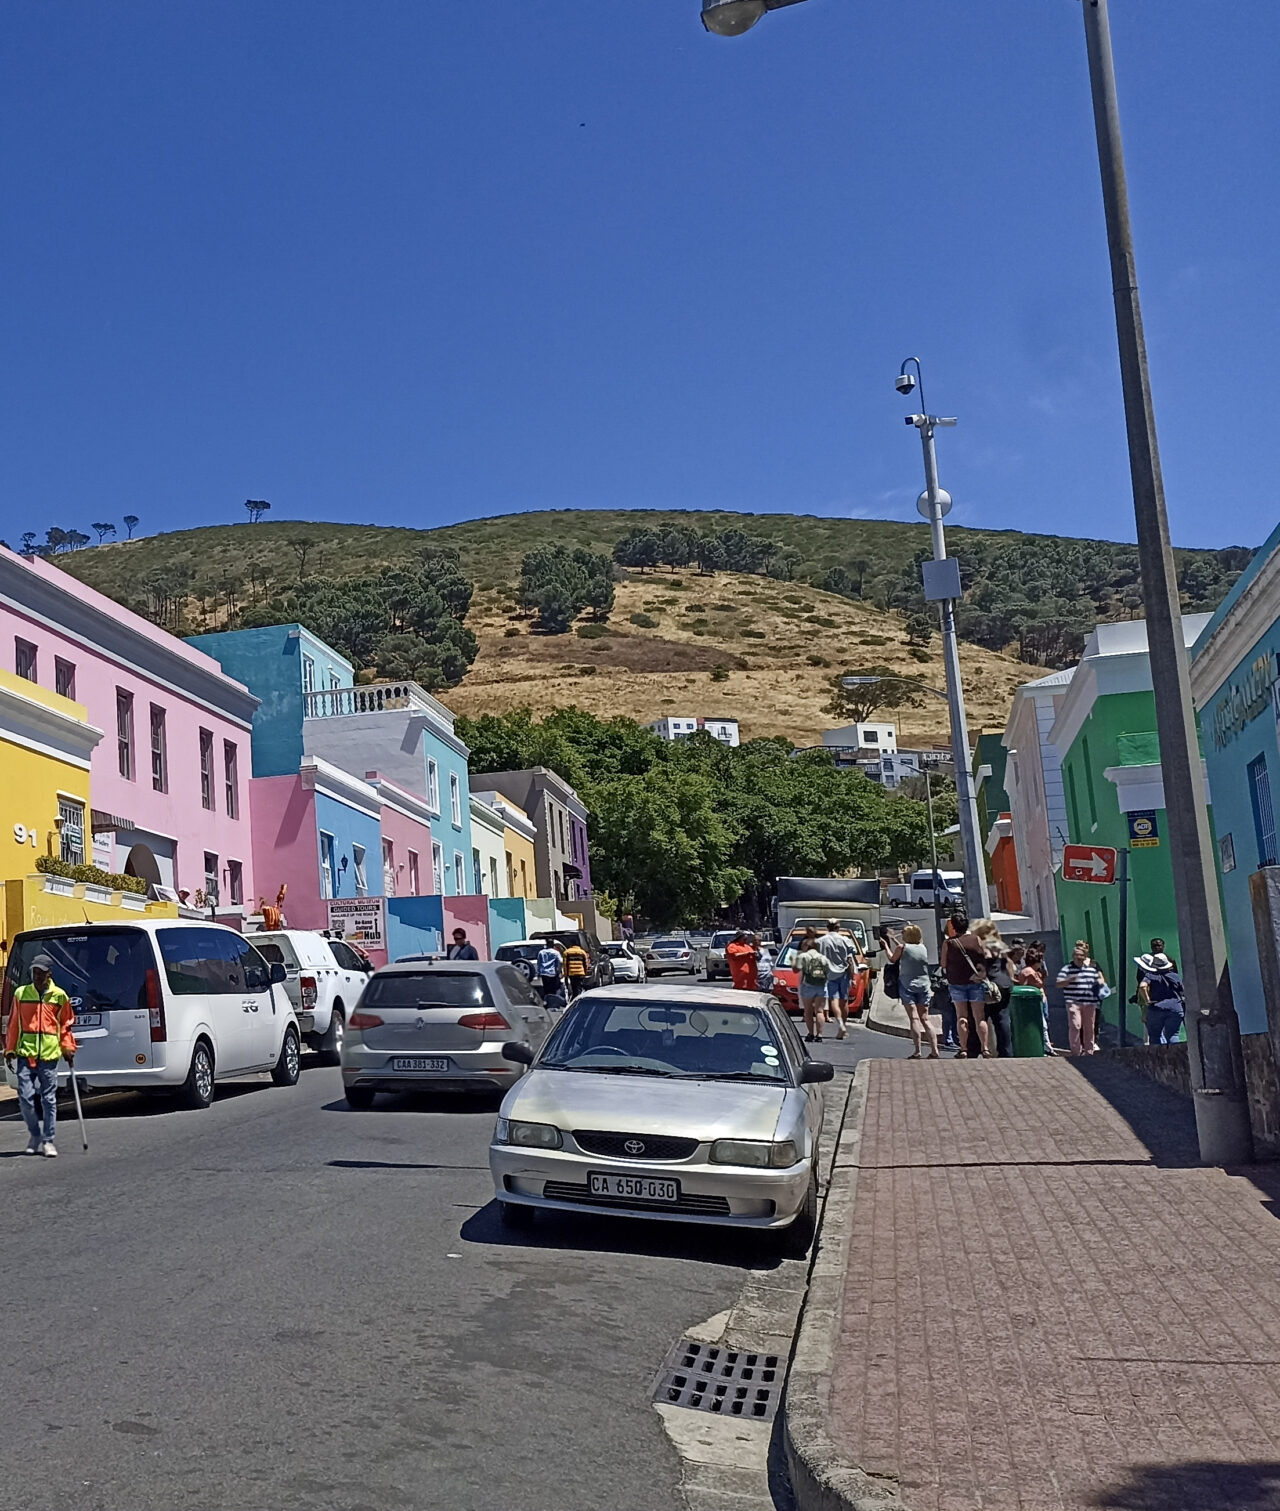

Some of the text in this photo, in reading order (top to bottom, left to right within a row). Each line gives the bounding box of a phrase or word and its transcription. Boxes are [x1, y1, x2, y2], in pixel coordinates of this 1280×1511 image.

[13, 823, 37, 848] 91
[397, 1060, 412, 1069] CAA
[592, 1176, 674, 1199] CA 650-030
